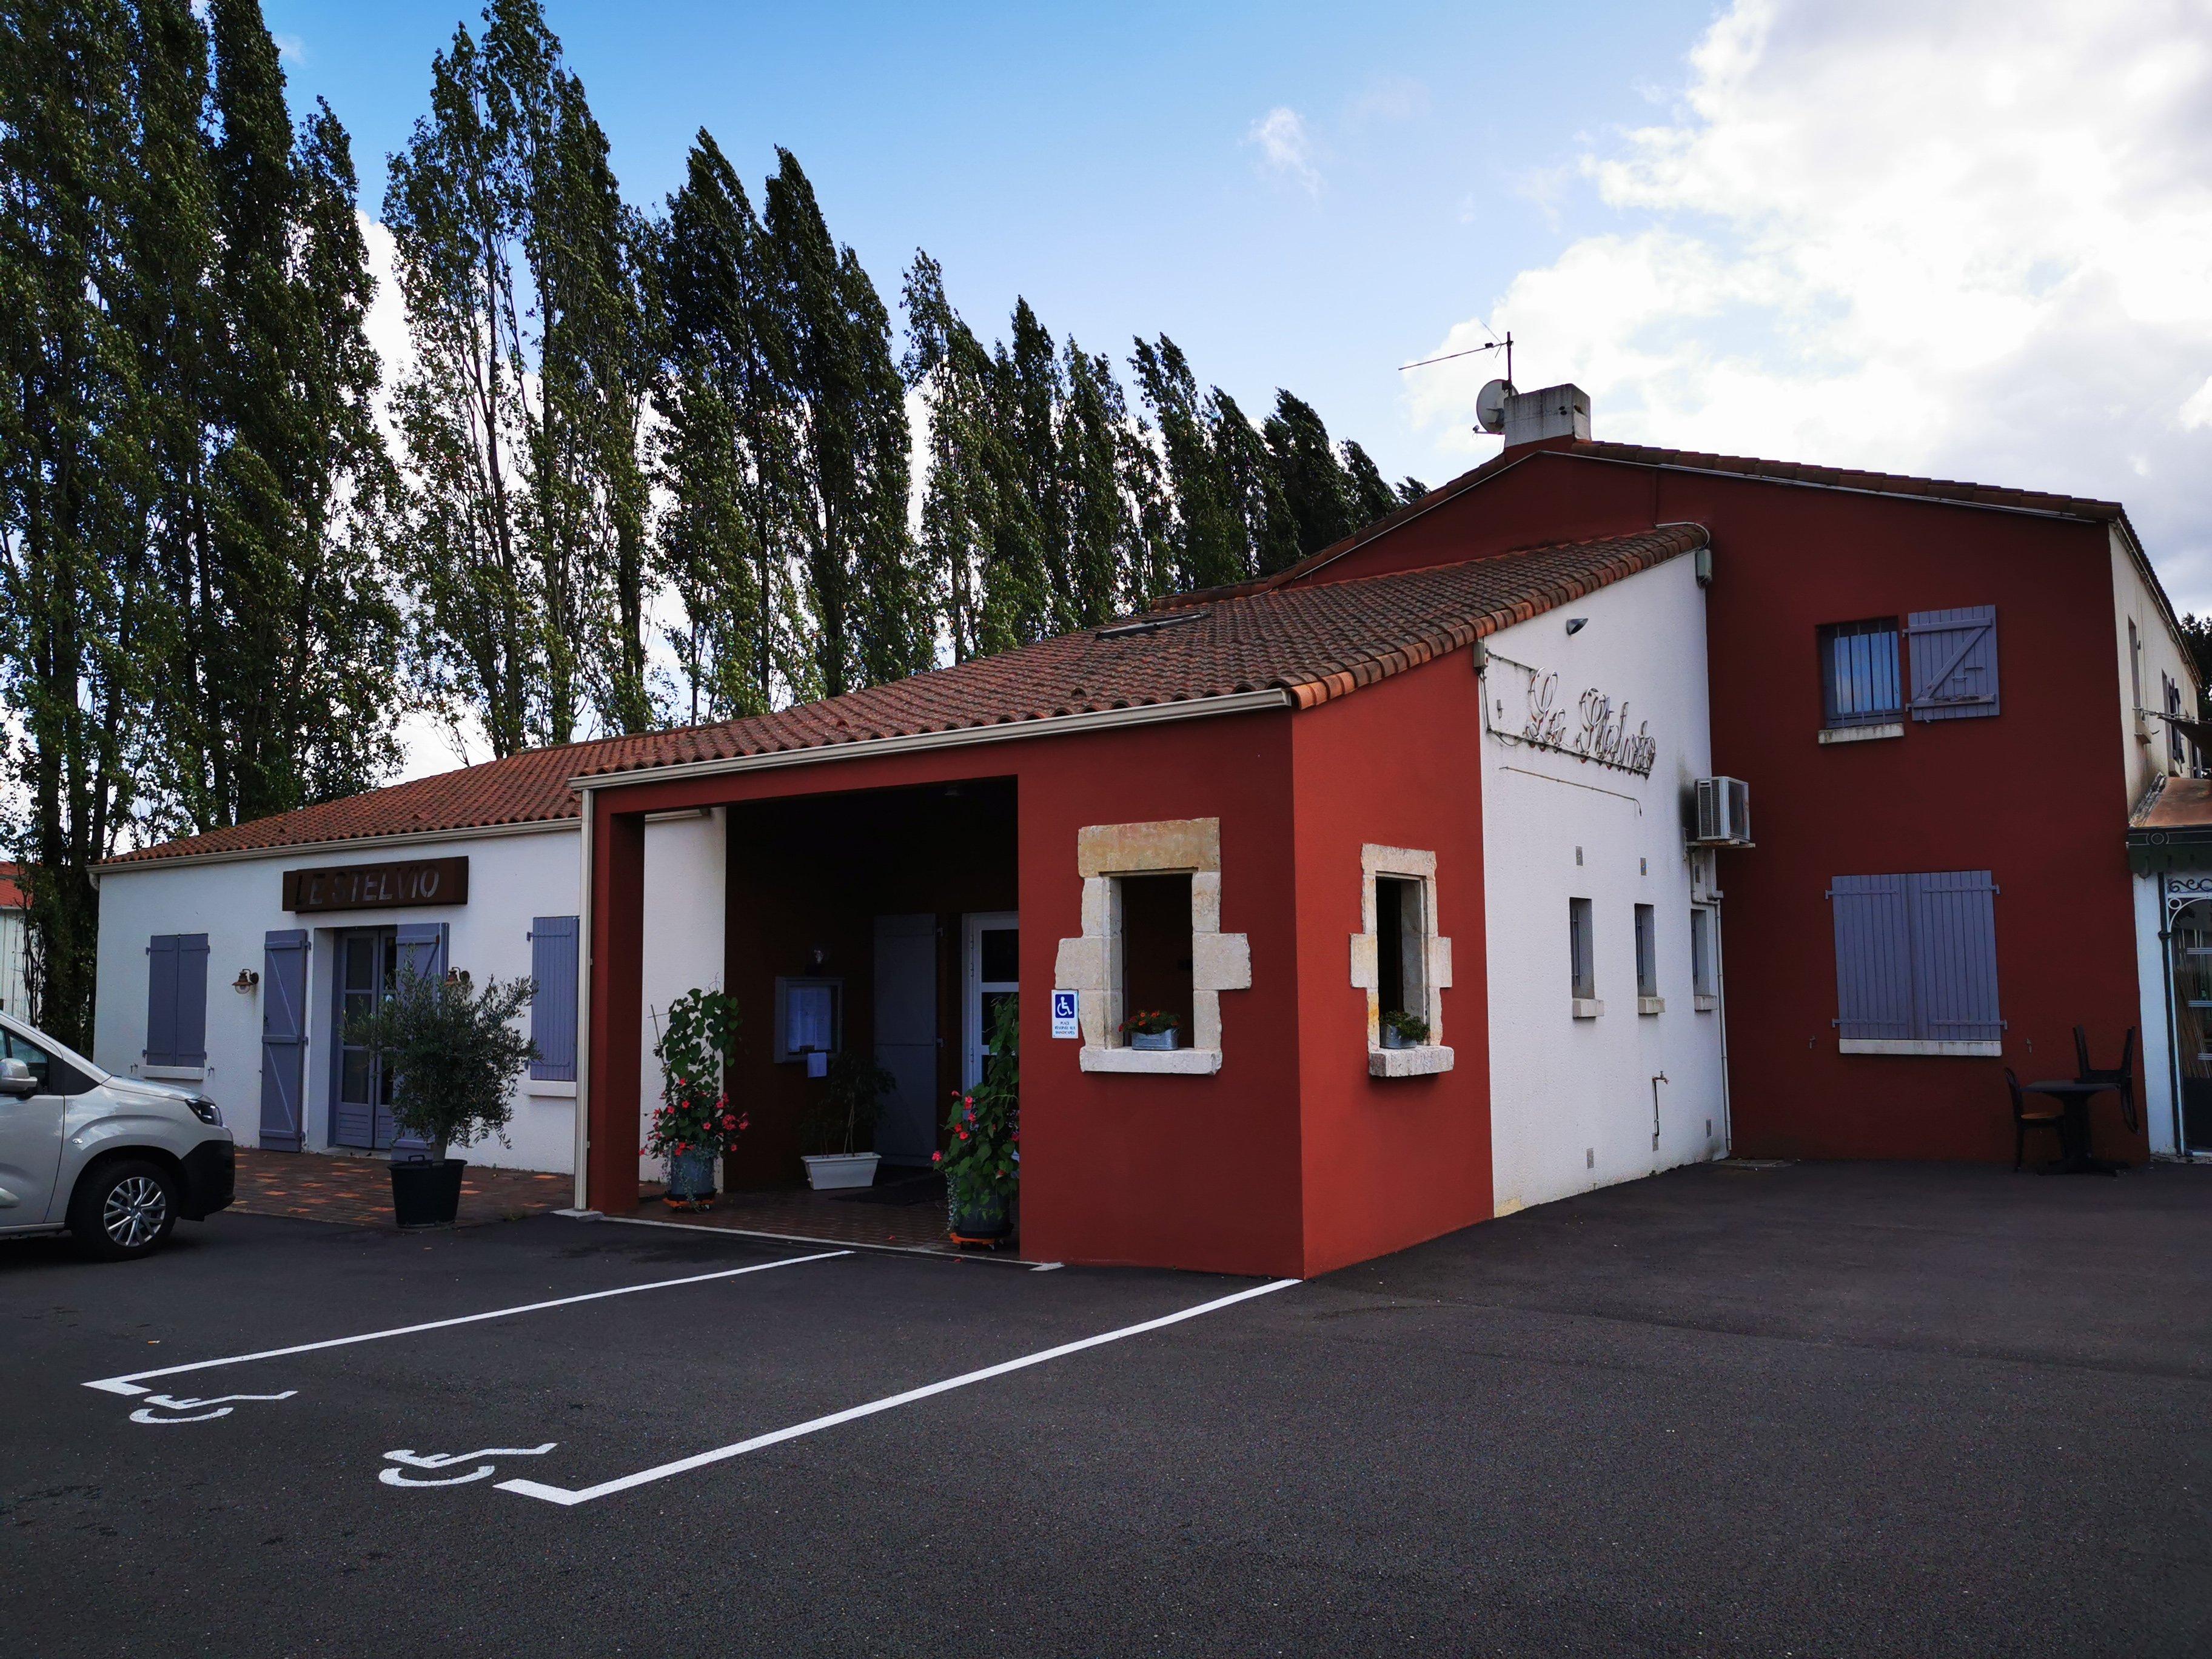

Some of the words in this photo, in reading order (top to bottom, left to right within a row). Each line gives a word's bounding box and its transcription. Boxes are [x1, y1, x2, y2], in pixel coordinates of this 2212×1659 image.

[1524, 667, 1567, 746] Le
[295, 874, 326, 905] LE
[332, 865, 440, 903] STELVIO
